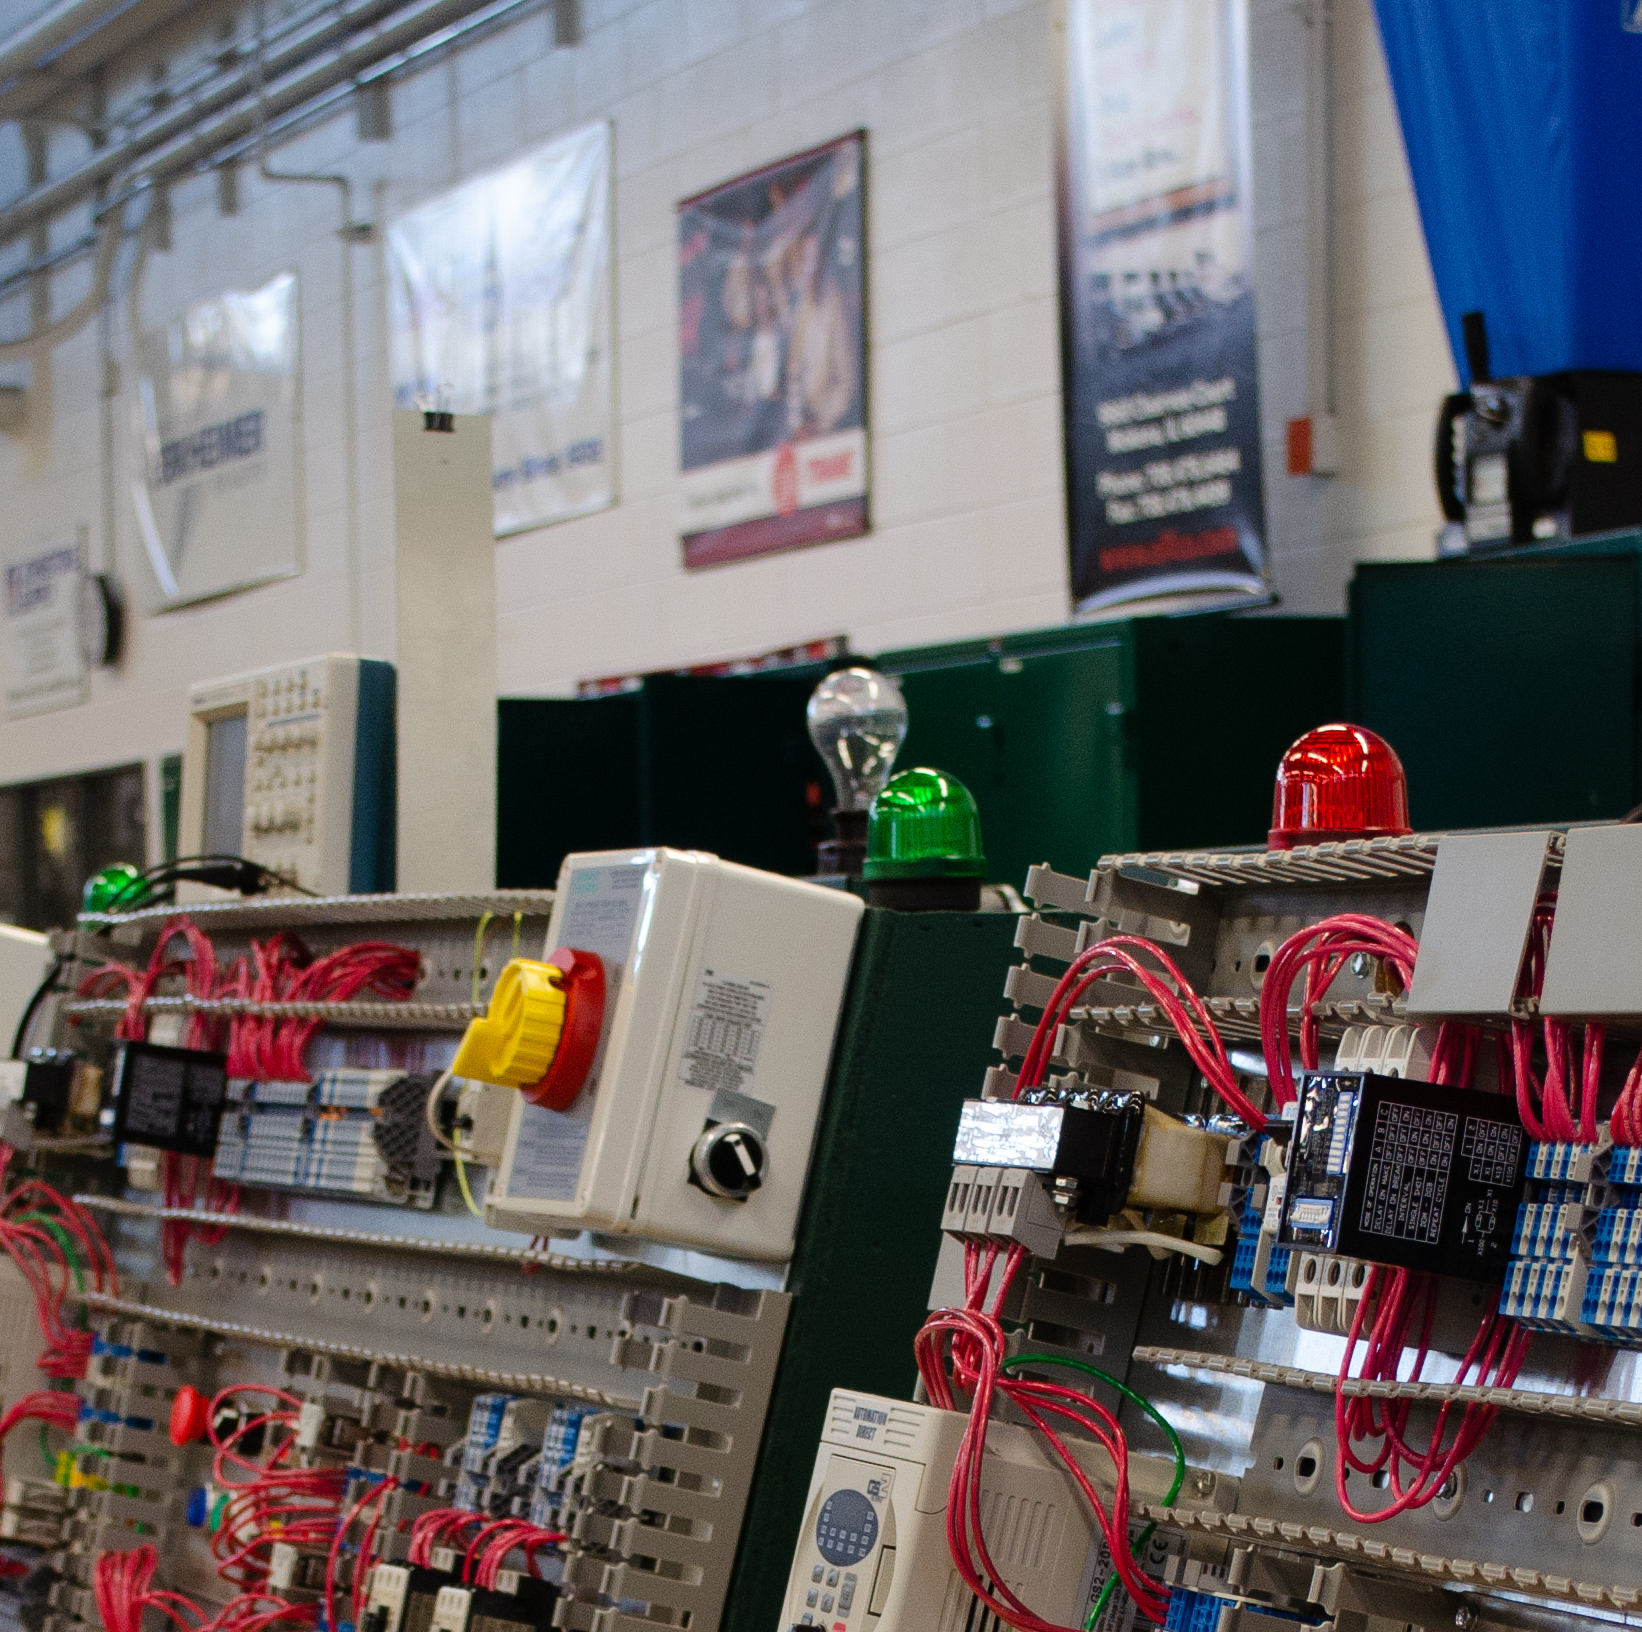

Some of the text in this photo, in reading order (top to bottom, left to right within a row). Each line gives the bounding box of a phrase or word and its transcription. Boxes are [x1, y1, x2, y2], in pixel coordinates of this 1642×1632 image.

[1384, 1208, 1395, 1235] DELAY
[1391, 1163, 1402, 1190] BREAK
[1398, 1181, 1411, 1222] INTERVAL
[1408, 1201, 1419, 1230] SINGLE
[1429, 1206, 1440, 1238] REPEAT
[1435, 1176, 1446, 1203] CYCLE
[1373, 1204, 1384, 1231] DELAY
[853, 1406, 888, 1426] AUTOMATION
[855, 1424, 877, 1441] DIRECT
[1090, 1540, 1111, 1604] GS2-20P
